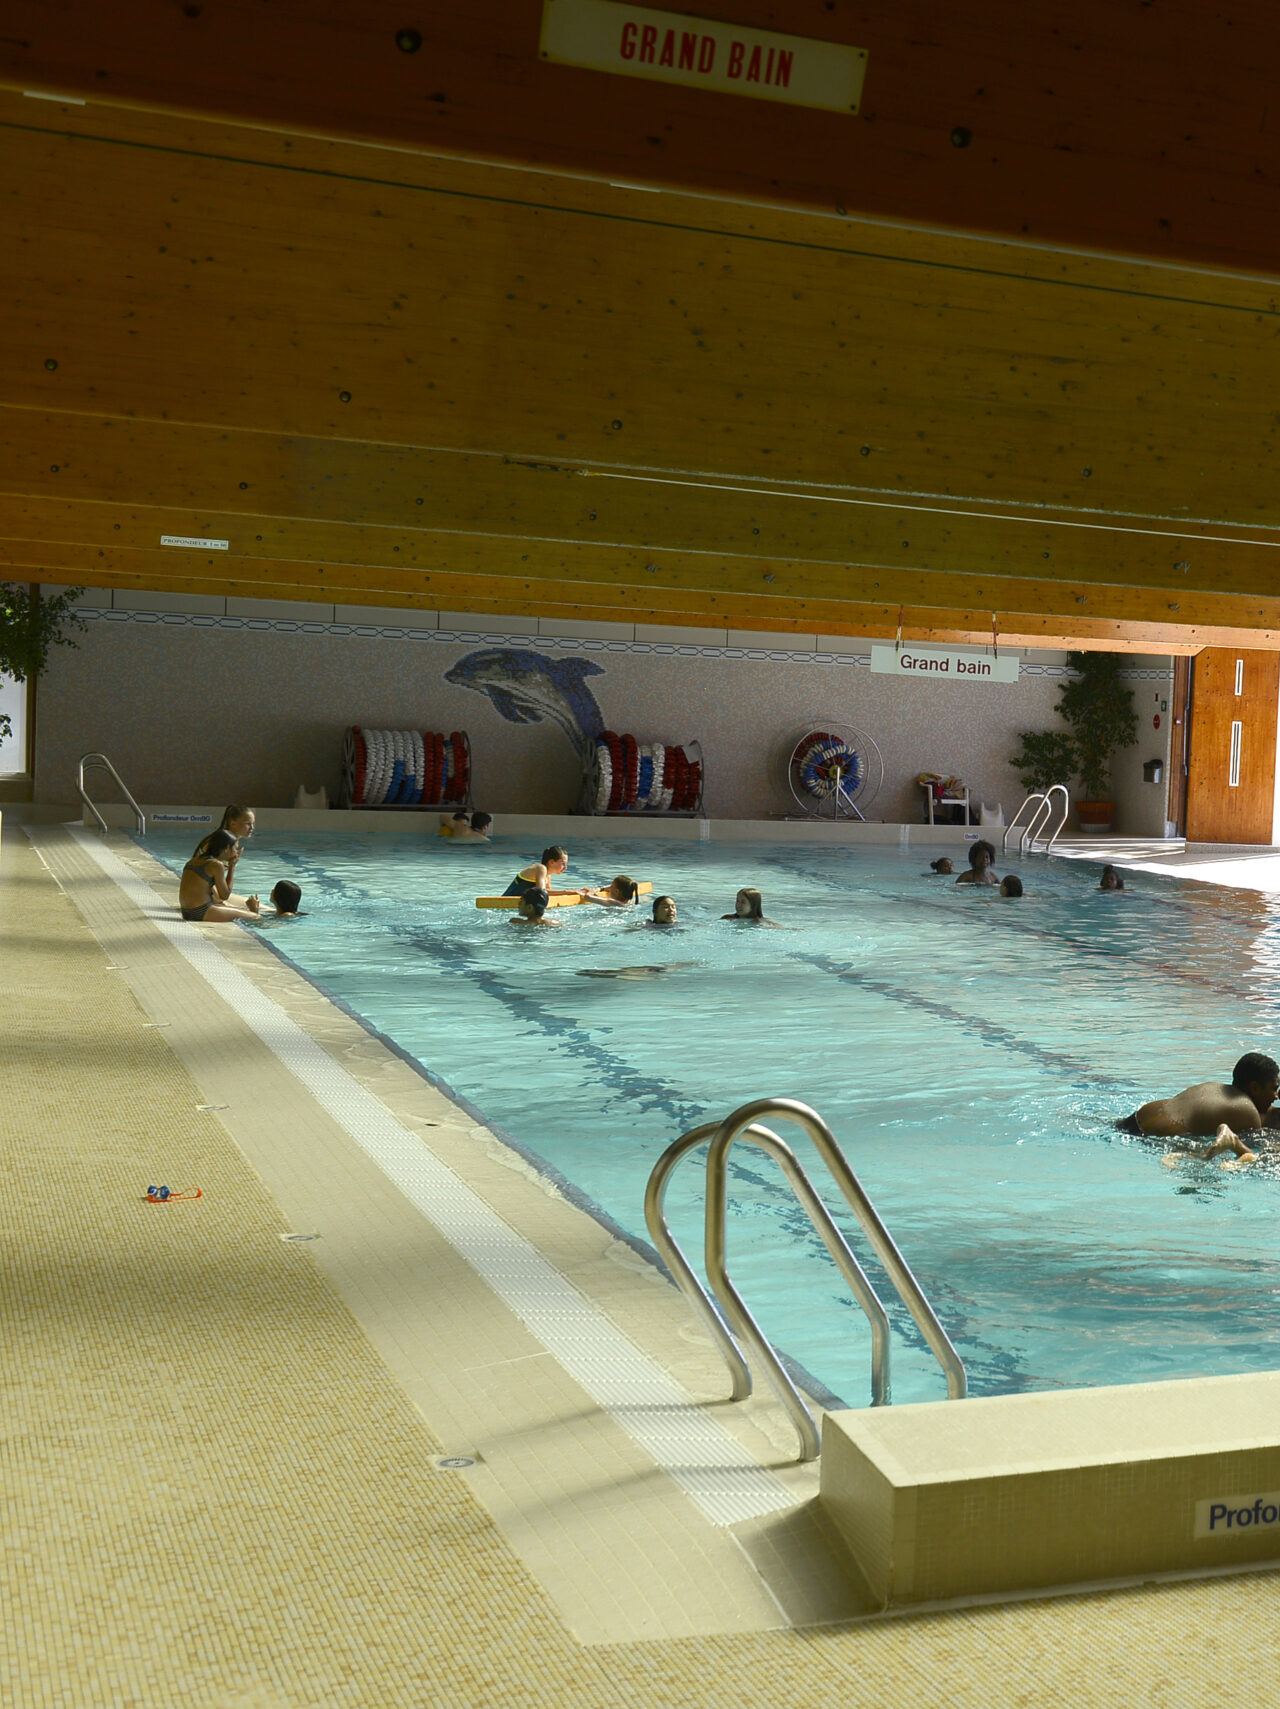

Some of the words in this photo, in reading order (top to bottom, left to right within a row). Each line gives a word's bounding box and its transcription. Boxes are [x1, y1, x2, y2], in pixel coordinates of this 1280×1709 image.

[620, 21, 716, 74] GRAND
[727, 41, 794, 88] BAIN
[900, 654, 949, 672] Grand
[957, 659, 991, 675] bain
